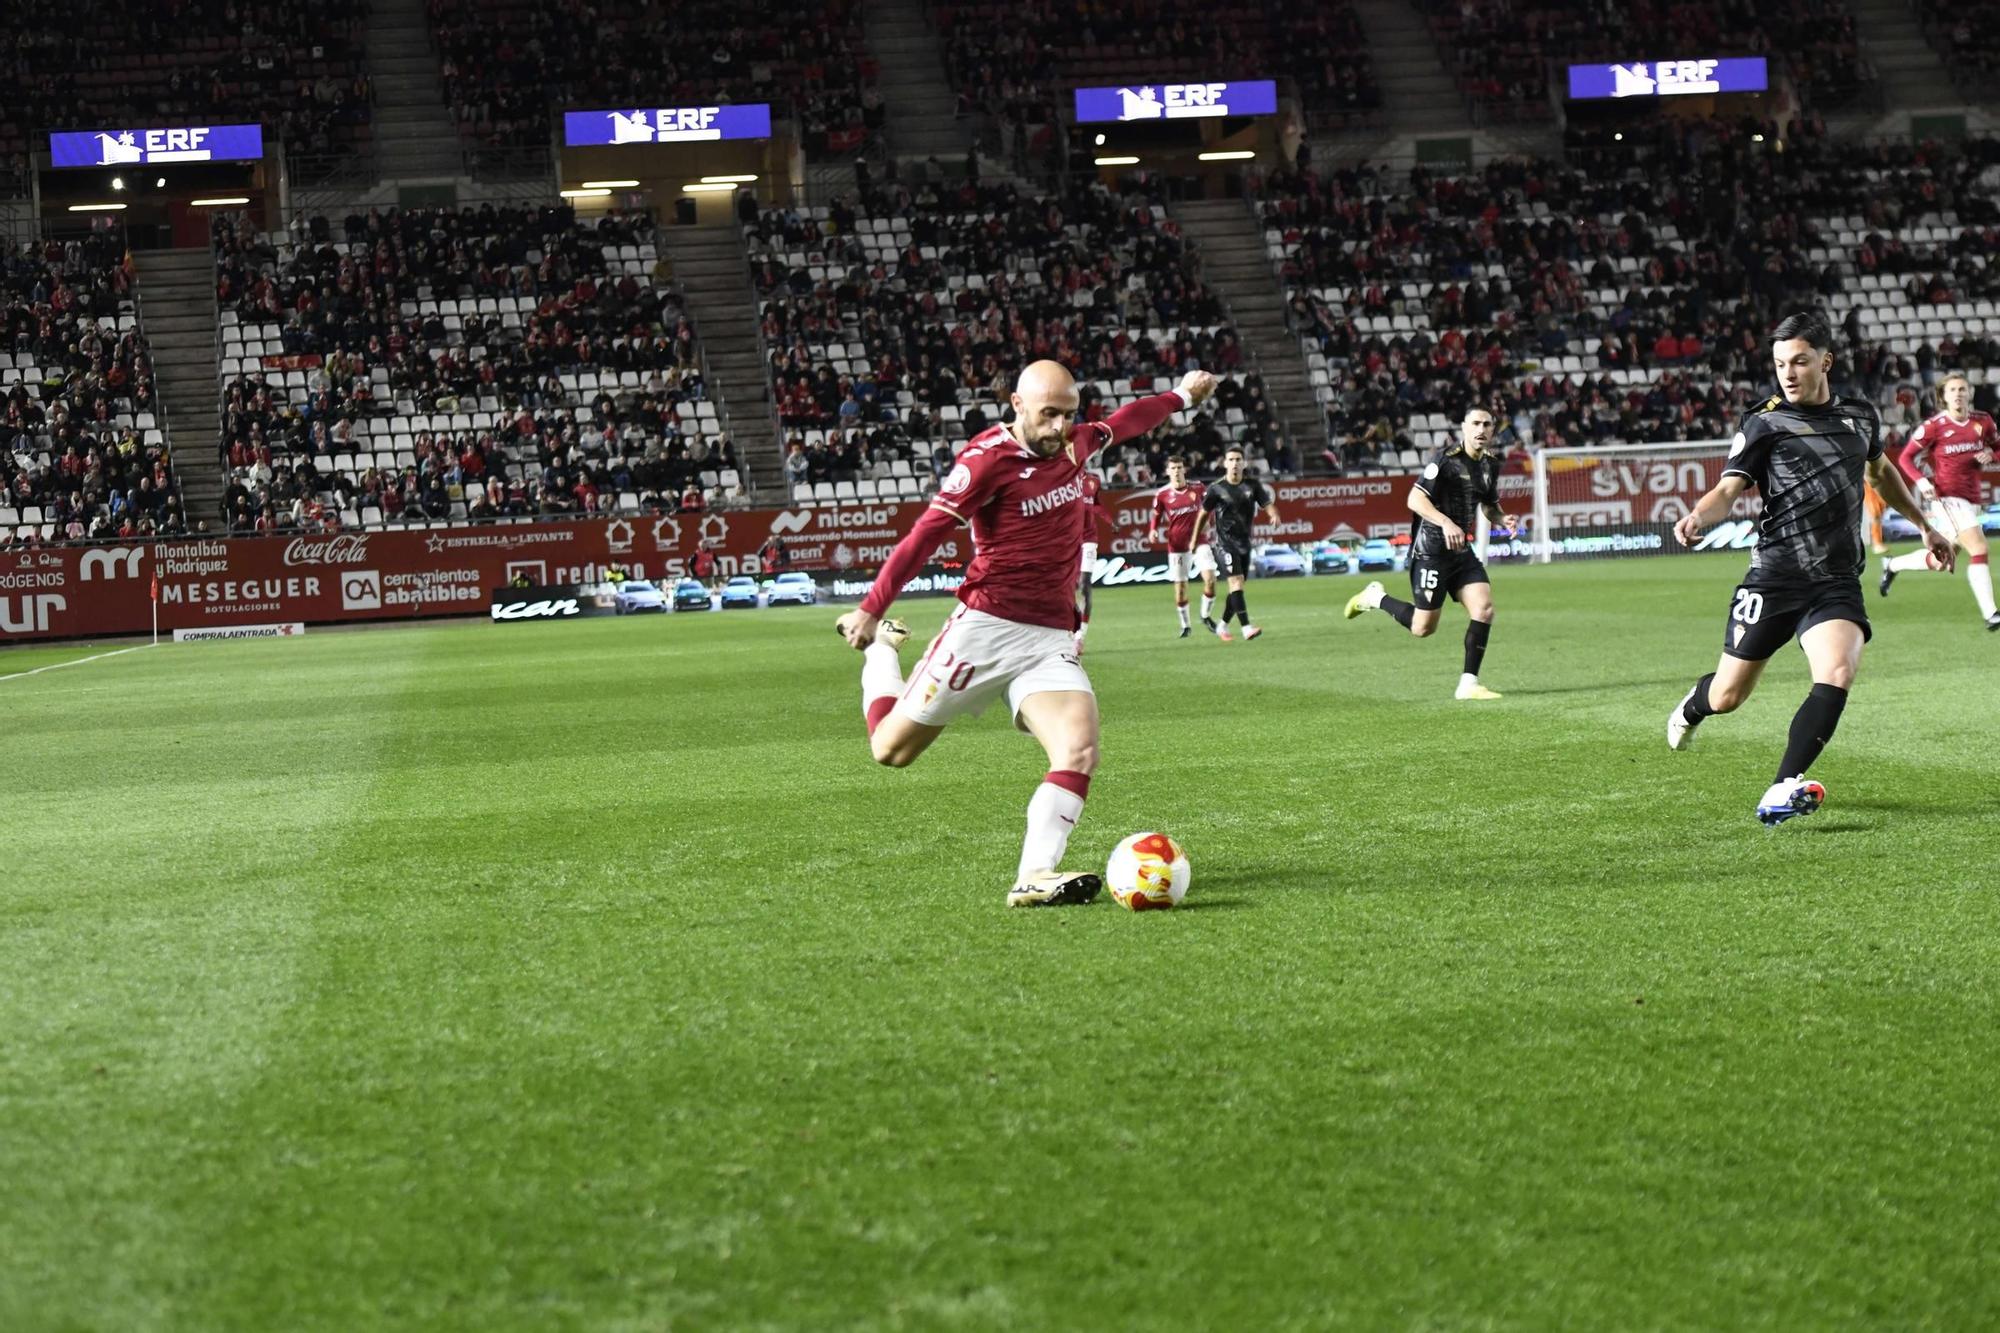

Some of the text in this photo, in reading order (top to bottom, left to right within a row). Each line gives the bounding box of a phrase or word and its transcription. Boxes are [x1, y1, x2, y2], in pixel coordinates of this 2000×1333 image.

[1656, 59, 1719, 82] ERF
[1164, 83, 1227, 107] ERF
[656, 107, 720, 131] ERF
[146, 128, 210, 151] ERF
[1592, 461, 1706, 496] svan
[1279, 482, 1392, 501] aparcamurcia
[447, 535, 508, 548] ESTRELLA
[519, 531, 574, 543] LEVANTE
[843, 529, 897, 540] Momentos
[1613, 533, 1661, 550] Electric
[155, 541, 227, 559] Montalbán
[156, 559, 229, 578] y Rodríguez
[1420, 568, 1439, 589] 15
[162, 576, 321, 604] MESEGUER
[345, 578, 377, 600] CA
[385, 585, 482, 605] abatibles
[205, 603, 281, 614] ROTULACIONES
[1732, 588, 1764, 625] 20
[183, 628, 278, 641] COMPRALAENTRADA
